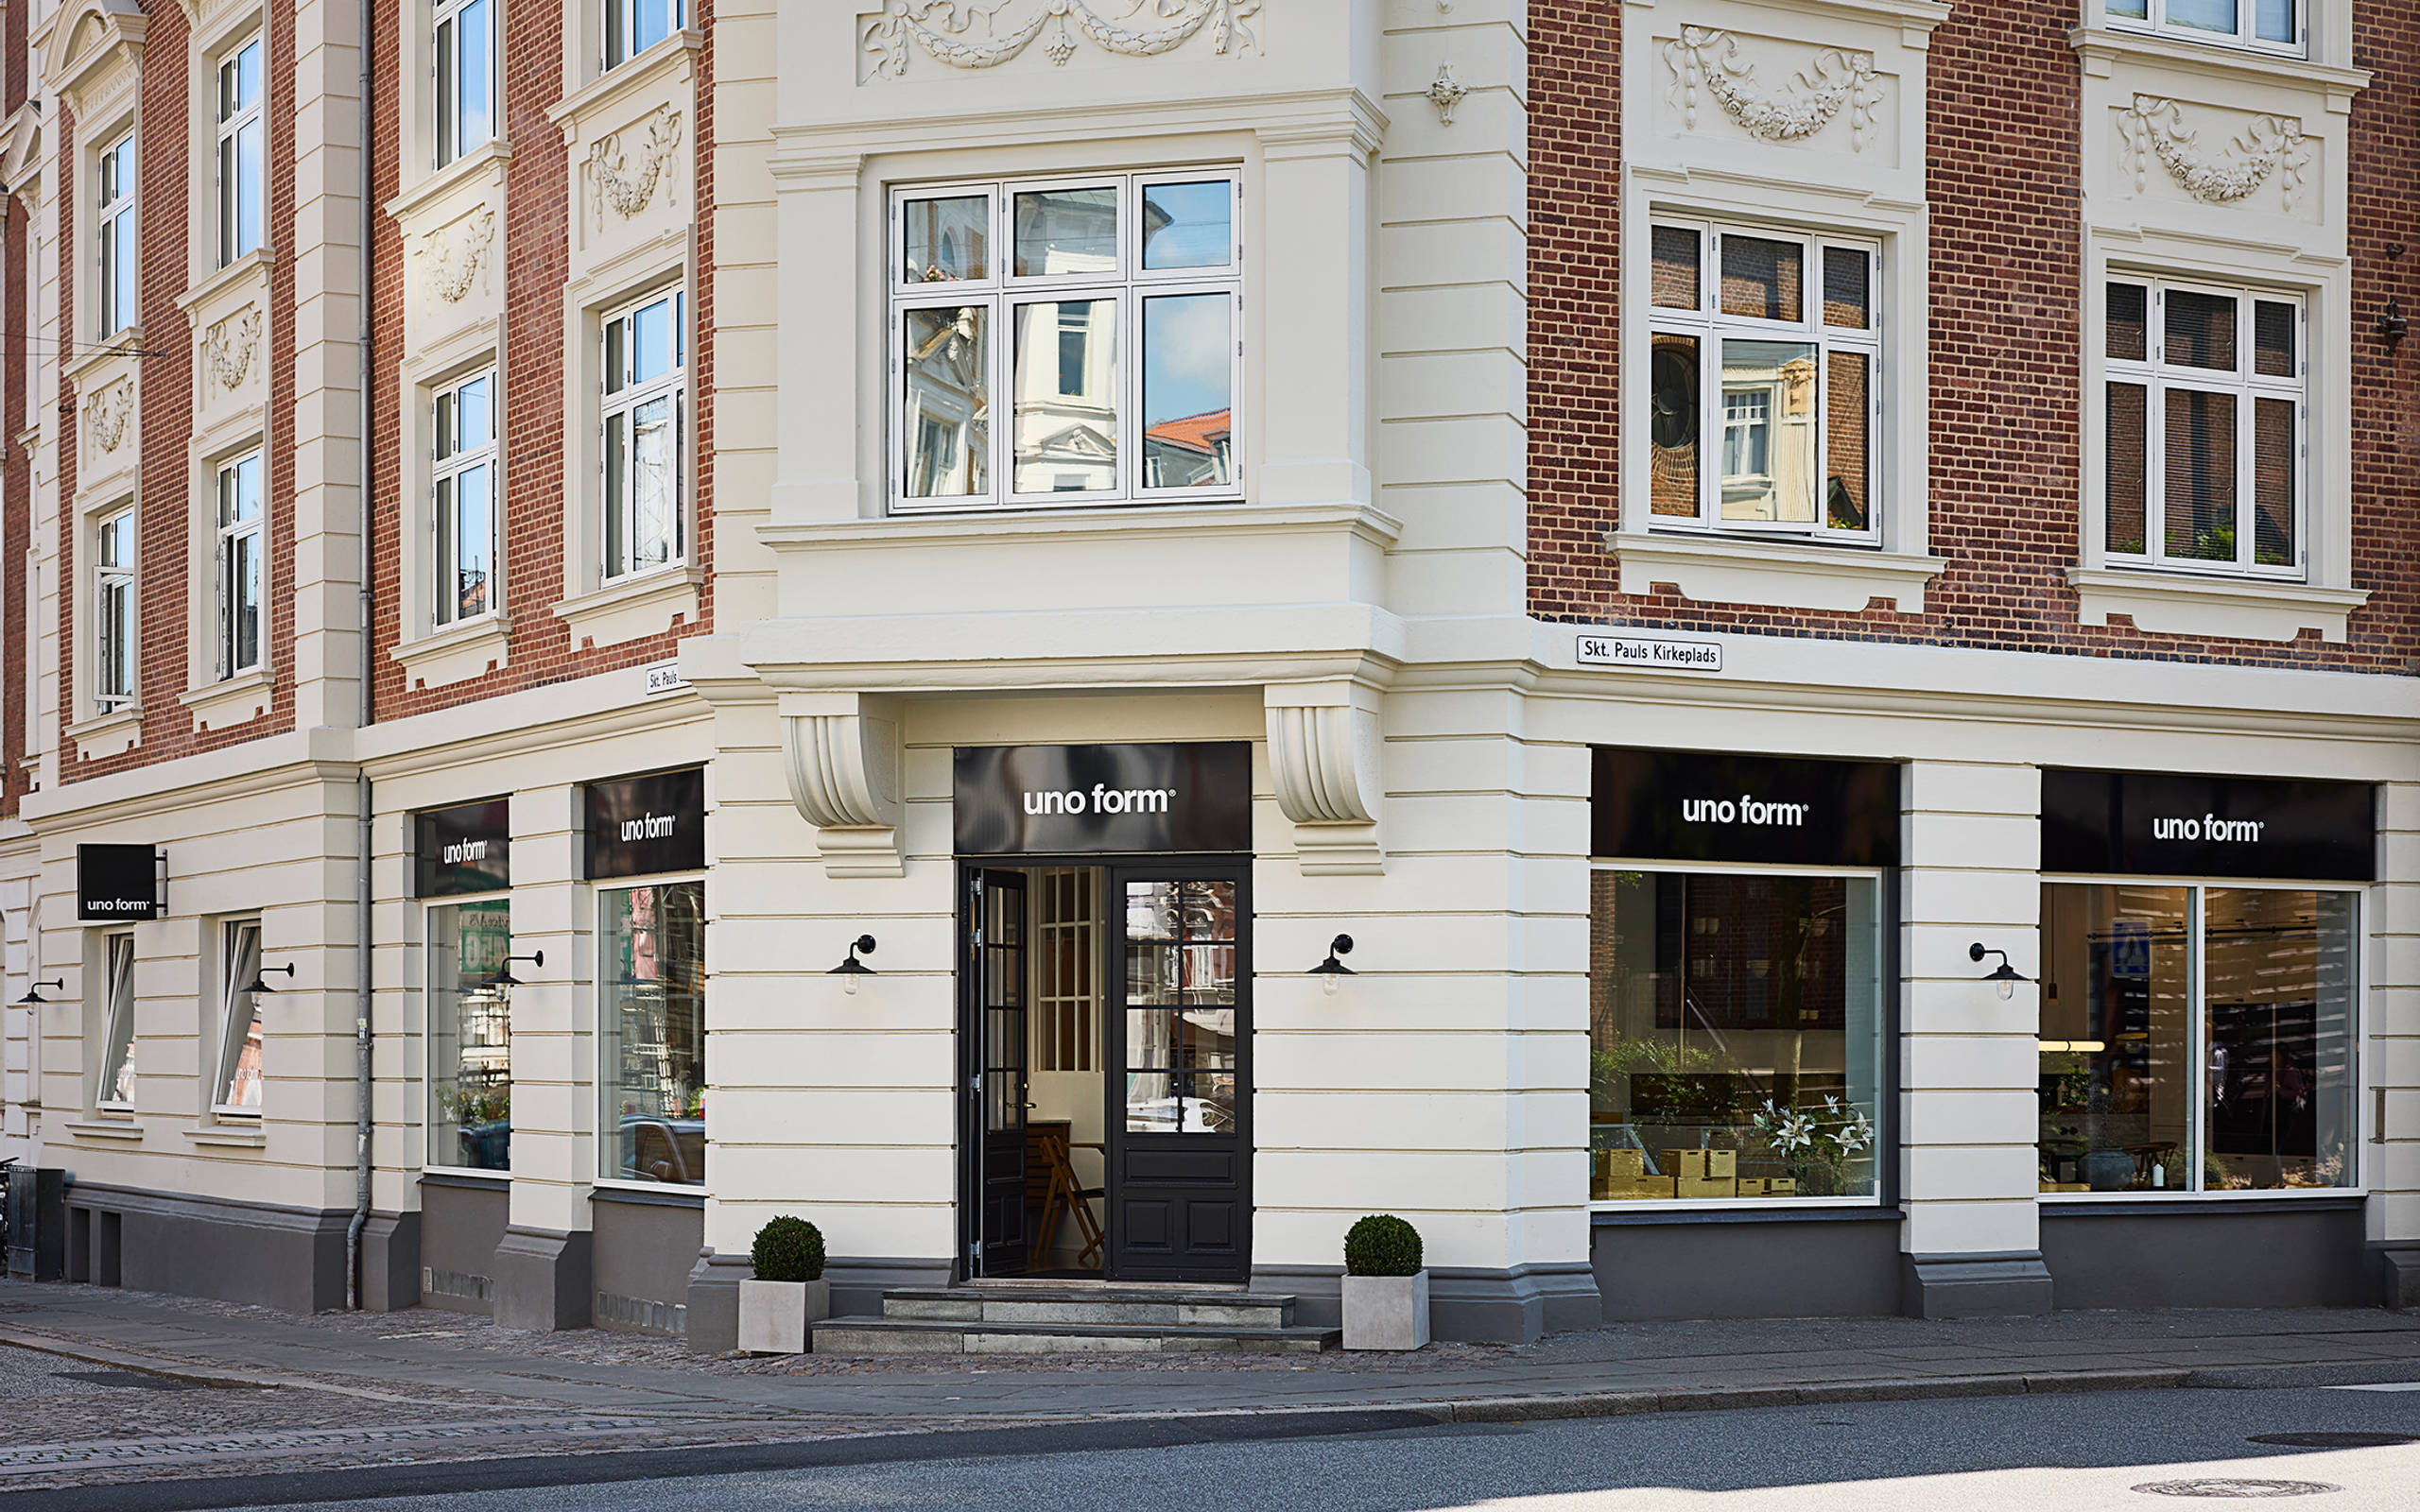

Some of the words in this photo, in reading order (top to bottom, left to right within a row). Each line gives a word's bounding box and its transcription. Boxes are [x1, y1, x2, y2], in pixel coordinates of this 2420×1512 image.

[1584, 641, 1610, 657] Skt.
[1615, 642, 1648, 659] Pauls
[1653, 644, 1717, 664] Kirkeplads
[663, 670, 677, 686] Pauls
[1024, 790, 1086, 815] uno
[1683, 799, 1736, 823] uno
[621, 819, 644, 842] uno
[2153, 817, 2200, 840] uno
[443, 843, 461, 864] uno
[87, 901, 113, 911] uno
